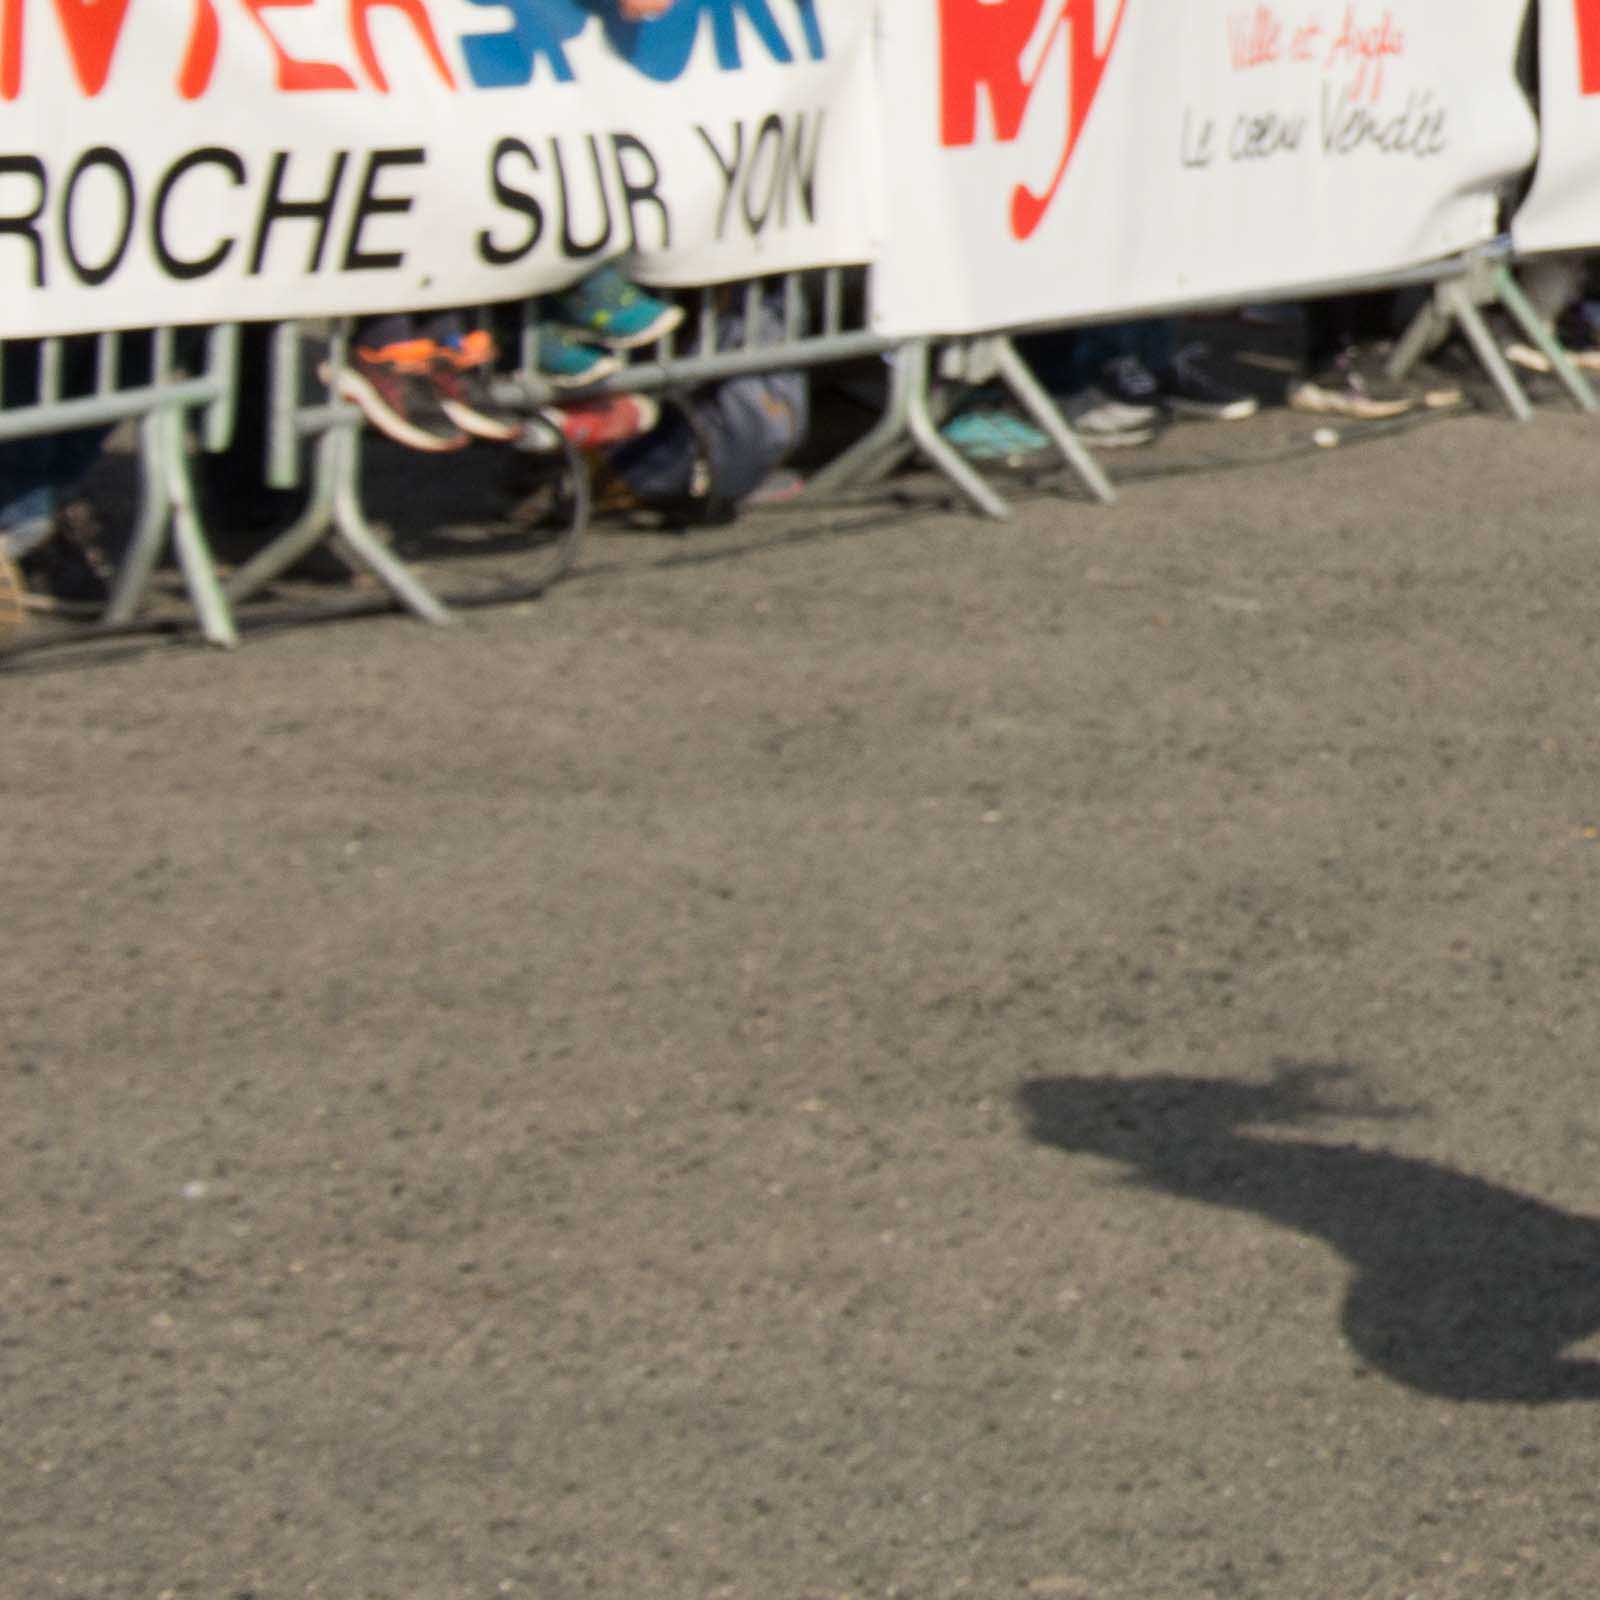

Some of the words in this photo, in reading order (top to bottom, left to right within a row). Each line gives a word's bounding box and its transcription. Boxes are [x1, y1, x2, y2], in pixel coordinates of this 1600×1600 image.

[476, 134, 671, 262] SUR
[696, 108, 828, 240] YON
[1180, 103, 1216, 170] Le
